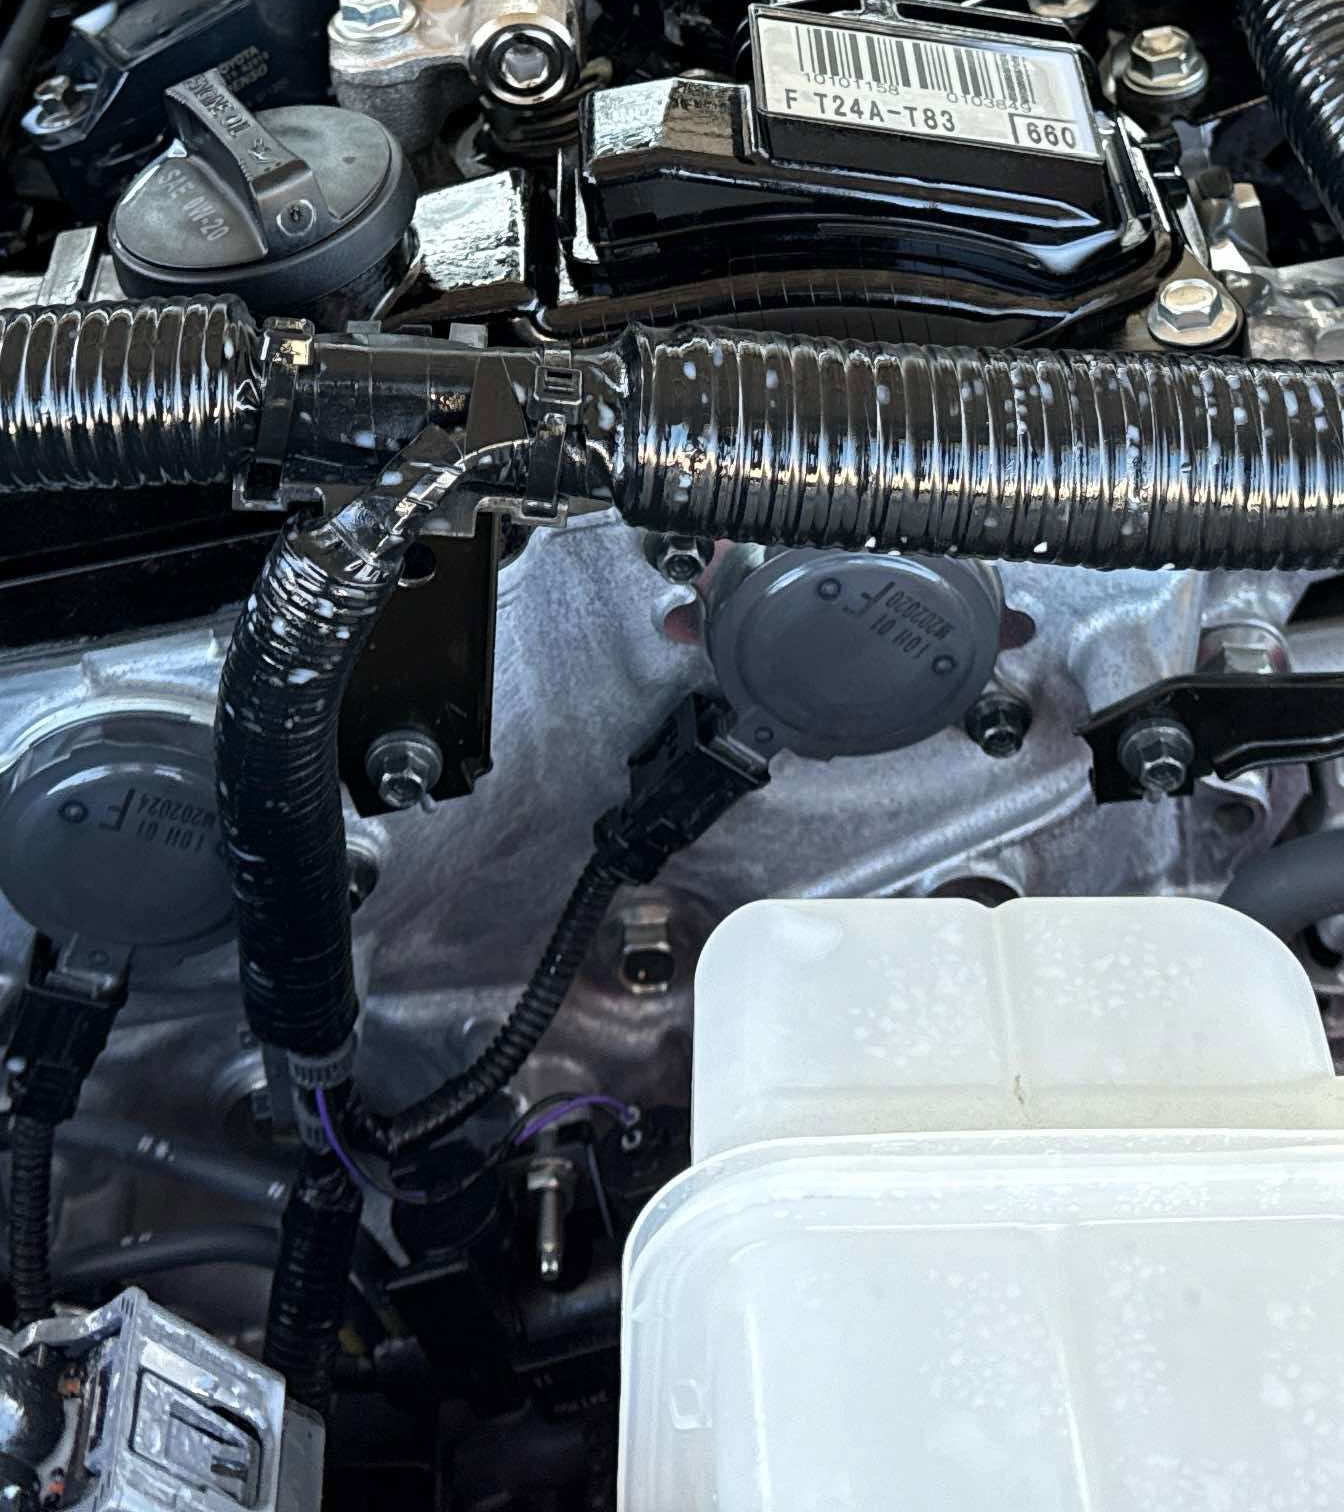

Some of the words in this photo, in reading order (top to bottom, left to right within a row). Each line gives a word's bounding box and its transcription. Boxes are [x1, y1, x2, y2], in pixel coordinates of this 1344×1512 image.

[813, 91, 956, 133] T24A-T83
[1026, 121, 1077, 150] 660
[158, 169, 195, 200] SAE
[183, 195, 230, 241] 0W-20
